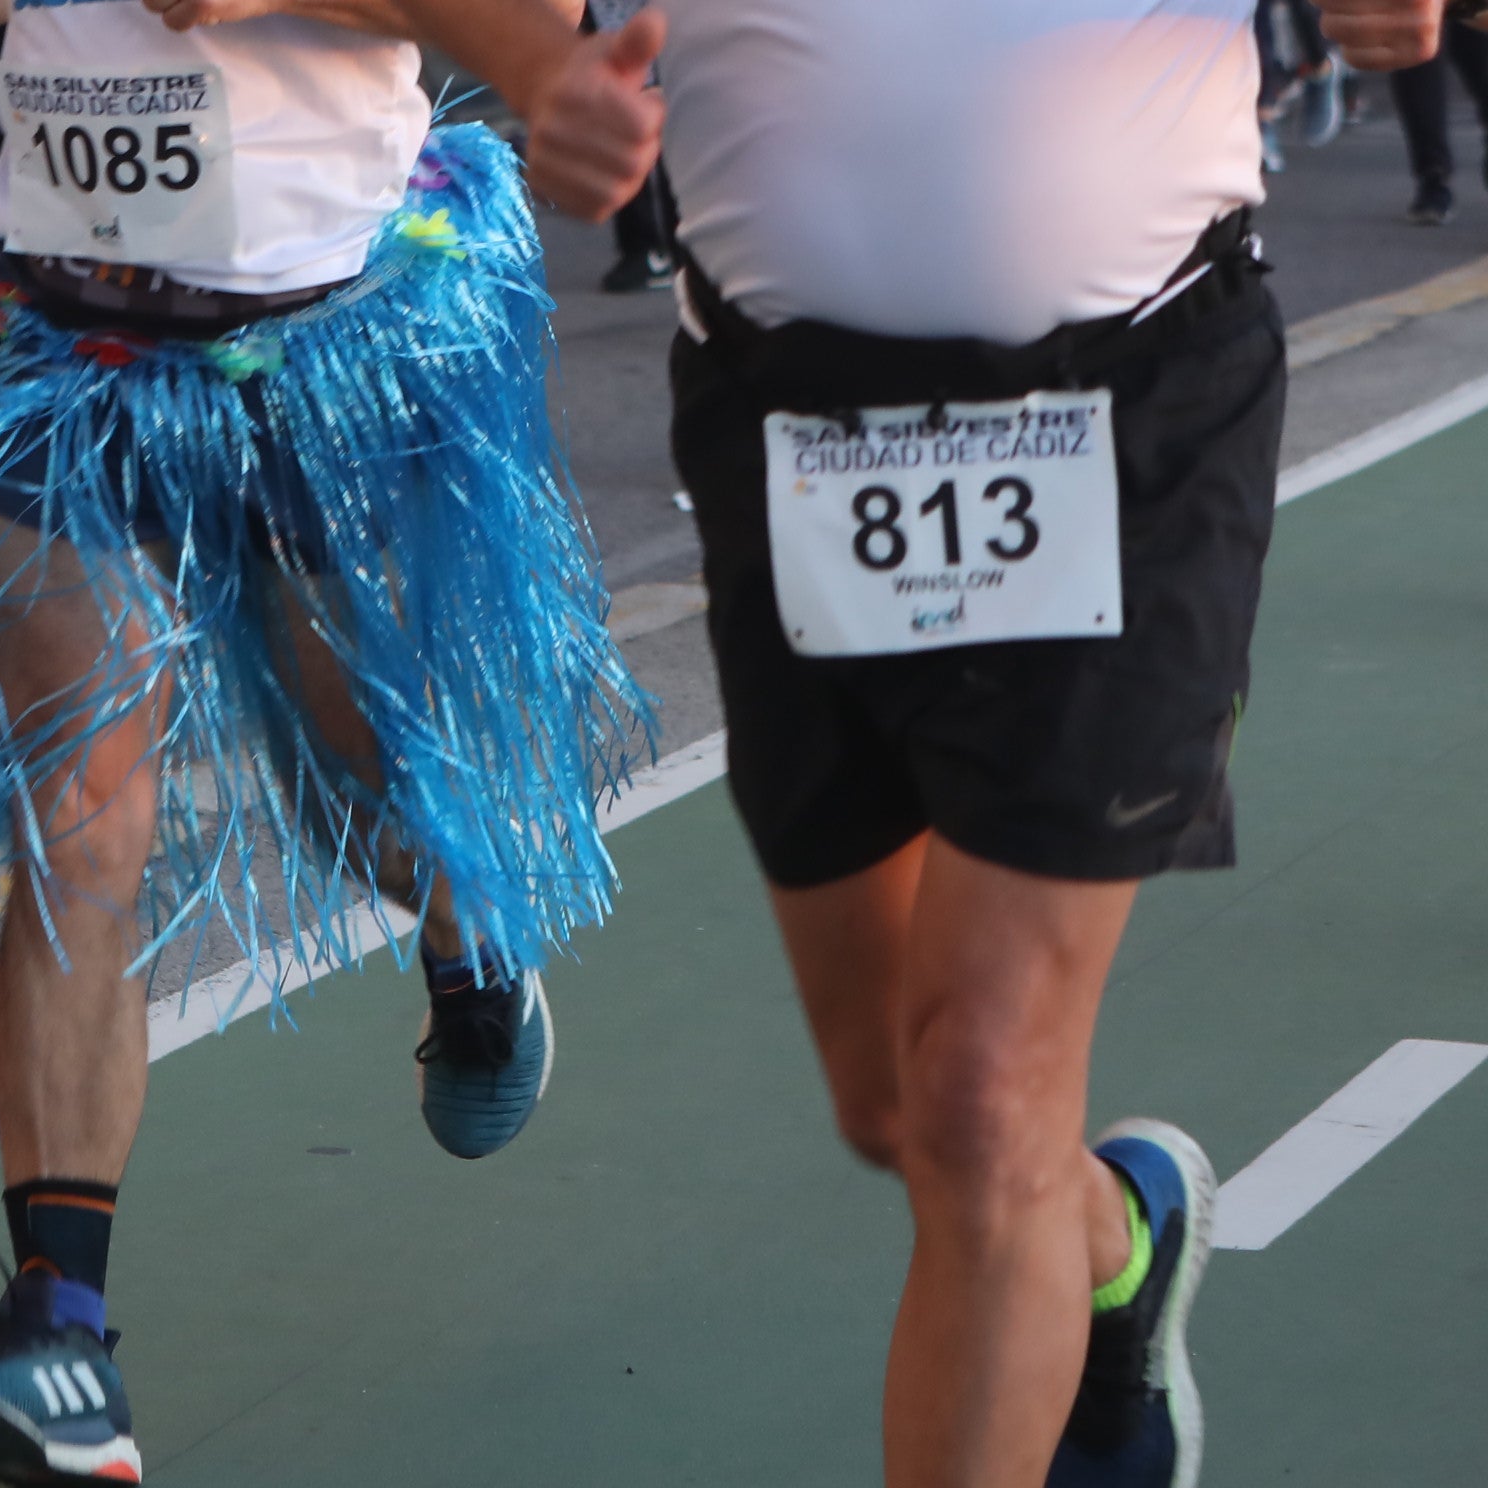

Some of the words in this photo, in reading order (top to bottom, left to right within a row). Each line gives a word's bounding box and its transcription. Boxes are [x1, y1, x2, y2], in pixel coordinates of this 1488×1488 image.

[3, 73, 47, 91] SAN
[53, 73, 207, 94] SILVESTRE
[89, 95, 120, 116] DE
[32, 122, 200, 195] 1085
[796, 439, 923, 476] CIUDAD
[934, 440, 977, 466] DE
[851, 475, 1040, 571] 813
[892, 569, 1005, 595] WINSLOW
